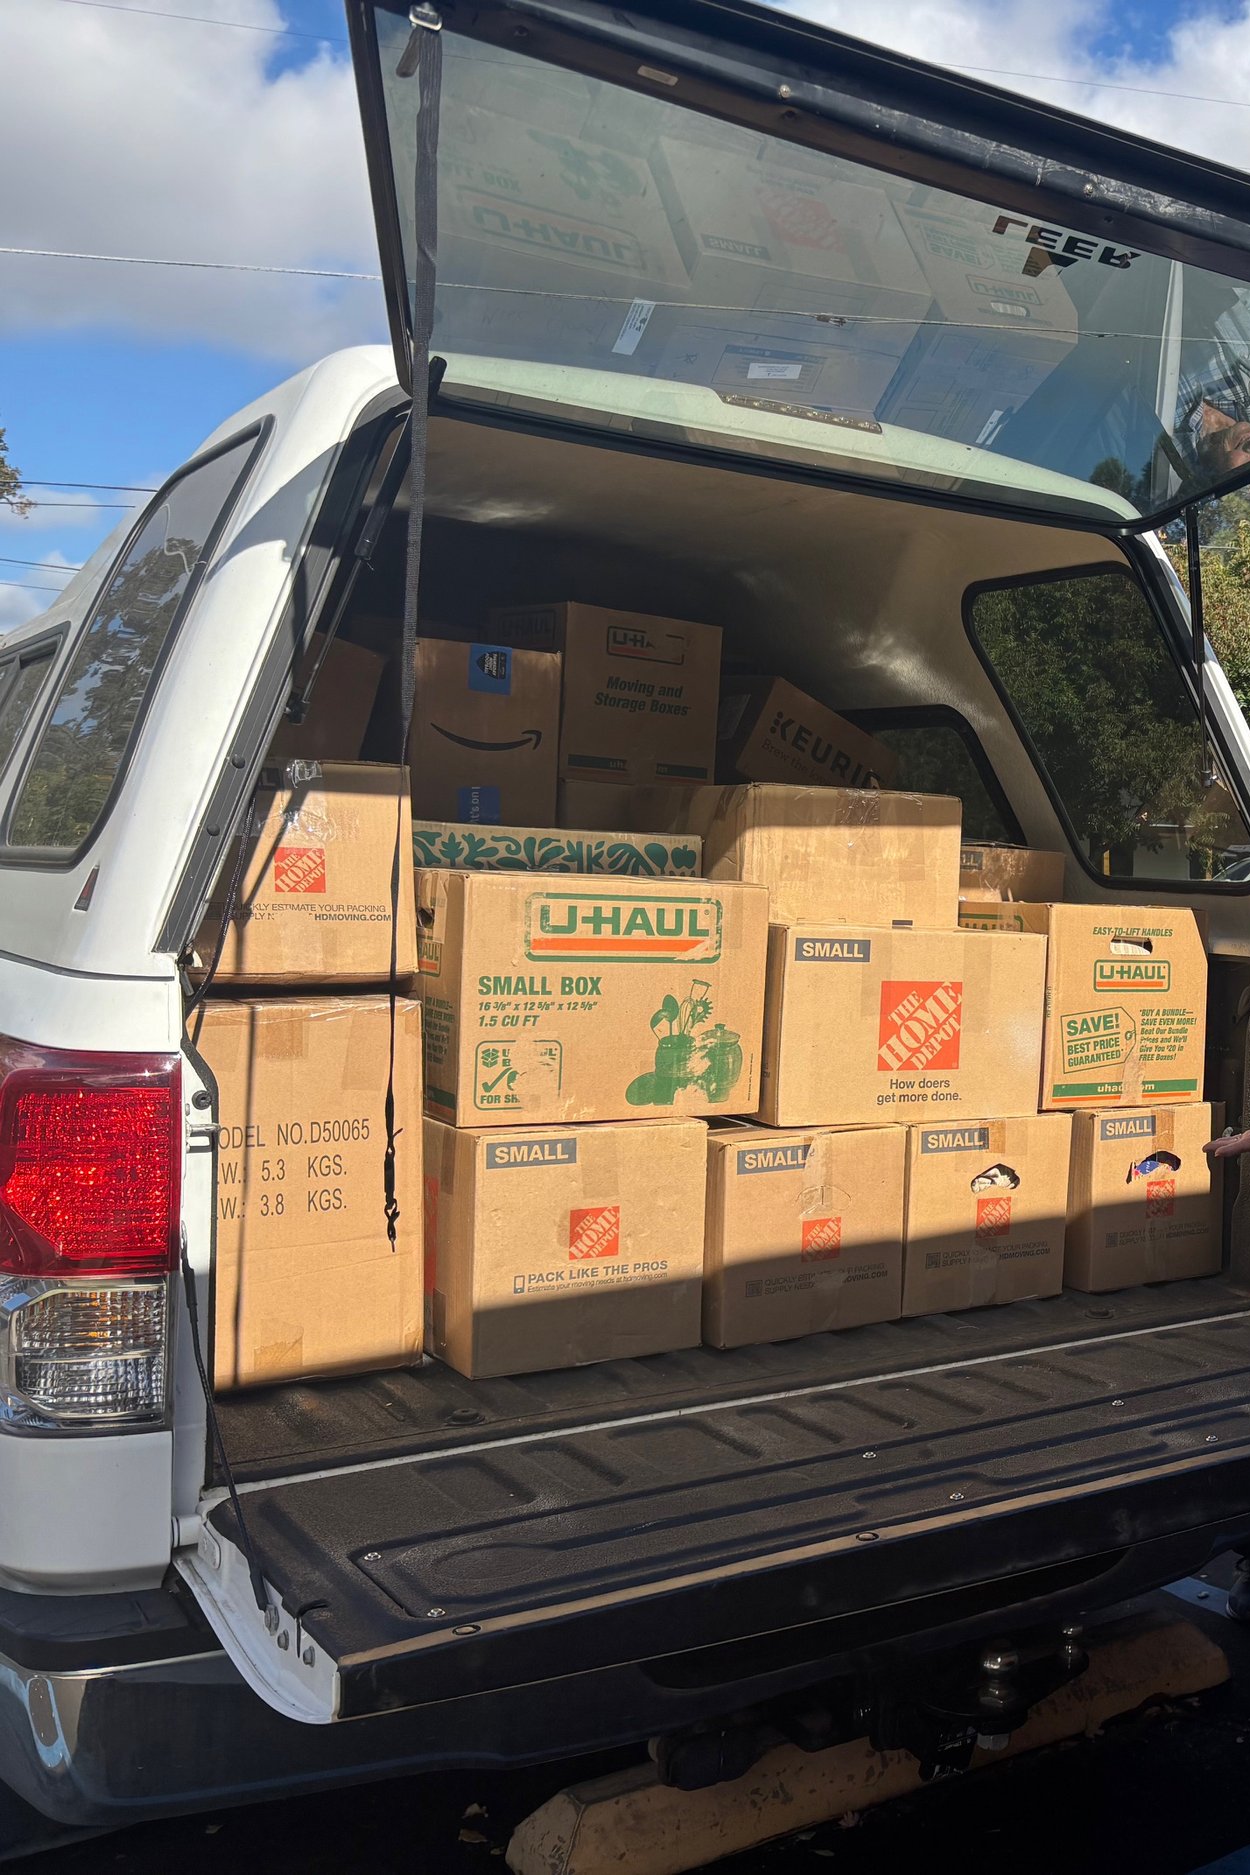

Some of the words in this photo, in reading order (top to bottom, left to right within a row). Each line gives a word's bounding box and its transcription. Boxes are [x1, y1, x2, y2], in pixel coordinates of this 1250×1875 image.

[606, 676, 655, 697] Moving
[658, 682, 683, 699] and
[594, 692, 647, 713] Storage
[650, 698, 689, 716] Boxes
[275, 848, 326, 892] HOME
[277, 852, 300, 870] THE
[296, 864, 325, 892] DEPOT
[272, 903, 317, 912] ESTIMATE
[318, 904, 345, 912] YOUR
[346, 904, 386, 913] PACKING
[314, 913, 392, 922] HDMOVING.COM
[540, 904, 711, 937] U-HAUL
[1093, 927, 1140, 937] EASY-TO-LIFT
[1142, 928, 1174, 937] HANDLES
[802, 941, 864, 958] SMALL
[1100, 965, 1166, 980] U-HAUL
[478, 976, 553, 996] SMALL
[561, 976, 603, 996] BOX
[479, 1002, 491, 1011] 16
[523, 1002, 536, 1011] 12
[567, 1001, 579, 1011] 12
[888, 990, 924, 1027] THE
[479, 1015, 498, 1027] 1.5
[501, 1015, 519, 1027] CU
[522, 1015, 540, 1027] FT
[877, 981, 963, 1071] HOME
[1066, 1013, 1120, 1037] SAVE!
[1140, 1018, 1157, 1026] SAVE
[1158, 1018, 1175, 1026] EVEN
[1175, 1017, 1197, 1026] MORE!
[1140, 1027, 1155, 1035] Beat
[1167, 1027, 1188, 1035] Bundle
[909, 1013, 961, 1071] DEPOT
[1067, 1042, 1091, 1056] BEST
[1093, 1037, 1120, 1051] PRICE
[1139, 1045, 1154, 1053] Give
[1139, 1054, 1155, 1062] FREE
[1155, 1053, 1177, 1061] Boxes!
[890, 1078, 915, 1089] How
[918, 1077, 950, 1089] doers
[480, 1095, 502, 1105] FOR
[877, 1093, 896, 1106] get
[898, 1093, 928, 1103] more
[931, 1091, 962, 1102] done.
[1106, 1120, 1152, 1136] SMALL
[217, 1126, 266, 1150] ODEL
[927, 1131, 984, 1149] SMALL
[495, 1143, 569, 1164] SMALL
[744, 1150, 807, 1170] SMALL
[261, 1158, 286, 1182] 5.3
[307, 1154, 348, 1179] KGS.
[260, 1193, 285, 1217] 3.8
[307, 1188, 348, 1213] KGS.
[981, 1201, 995, 1218] THE
[569, 1207, 620, 1259] HOME
[575, 1213, 596, 1235] THE
[805, 1223, 822, 1241] THE
[588, 1224, 620, 1258] DEPOT
[941, 1257, 967, 1267] SUPPLY
[528, 1270, 565, 1284] PACK
[569, 1267, 599, 1280] LIKE
[603, 1263, 629, 1276] THE
[633, 1260, 668, 1273] PROS
[764, 1275, 797, 1287] QUICKLY
[854, 1263, 887, 1274] PACKING
[527, 1283, 555, 1293] Estimate
[556, 1282, 570, 1292] your
[571, 1279, 595, 1289] moving
[596, 1277, 615, 1286] needs
[764, 1283, 792, 1295] SUPPLY
